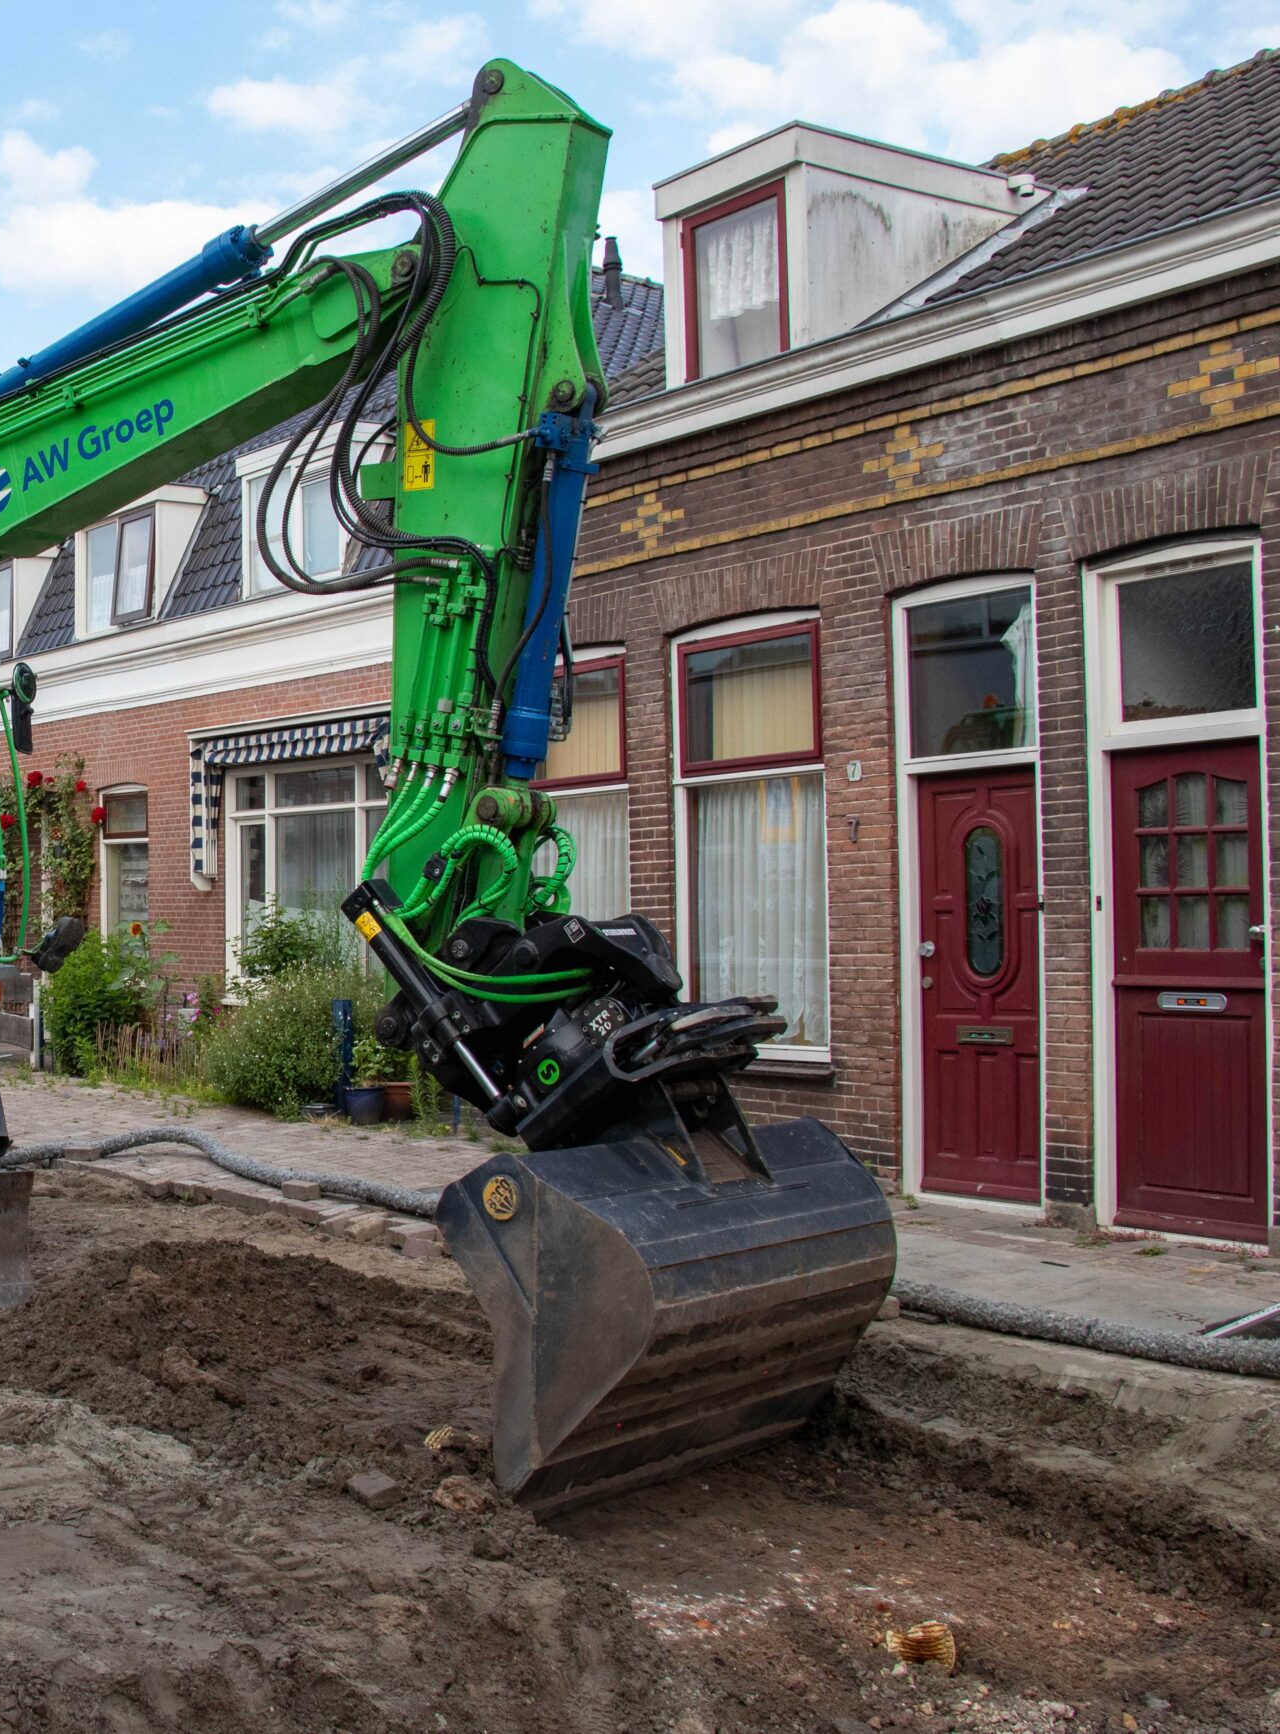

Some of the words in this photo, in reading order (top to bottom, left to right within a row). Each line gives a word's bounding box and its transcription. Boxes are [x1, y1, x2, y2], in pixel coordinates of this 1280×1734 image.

[22, 437, 69, 492] AW
[77, 398, 174, 461] Groep
[851, 763, 858, 779] 7
[589, 1009, 611, 1032] XTR
[598, 1021, 612, 1036] 20
[487, 1178, 511, 1210] BECO
